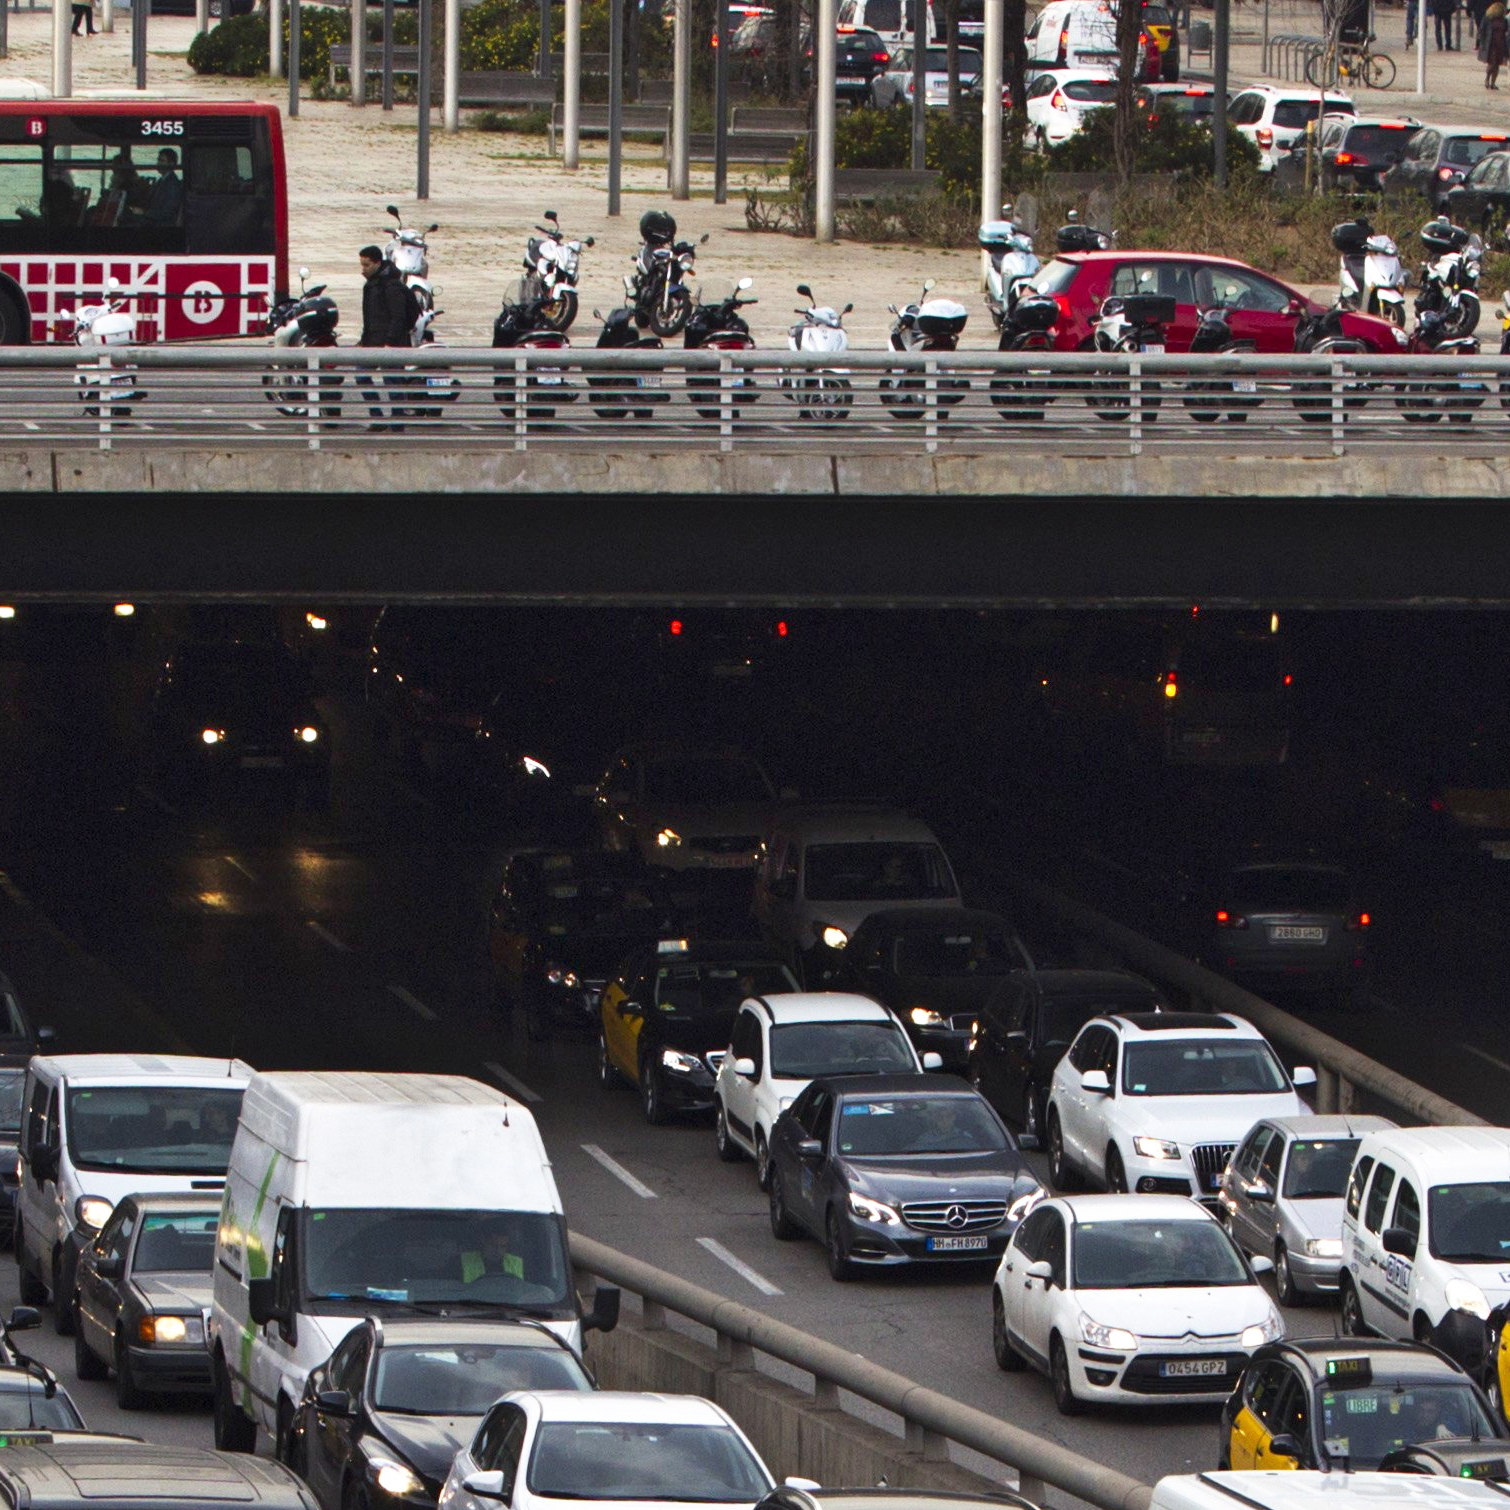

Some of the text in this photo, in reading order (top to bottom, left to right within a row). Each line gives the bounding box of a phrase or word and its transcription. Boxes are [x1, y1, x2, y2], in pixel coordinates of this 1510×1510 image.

[141, 121, 184, 135] 3455
[1167, 1361, 1226, 1375] 0454 GPZ
[1347, 1399, 1378, 1413] LIBRE
